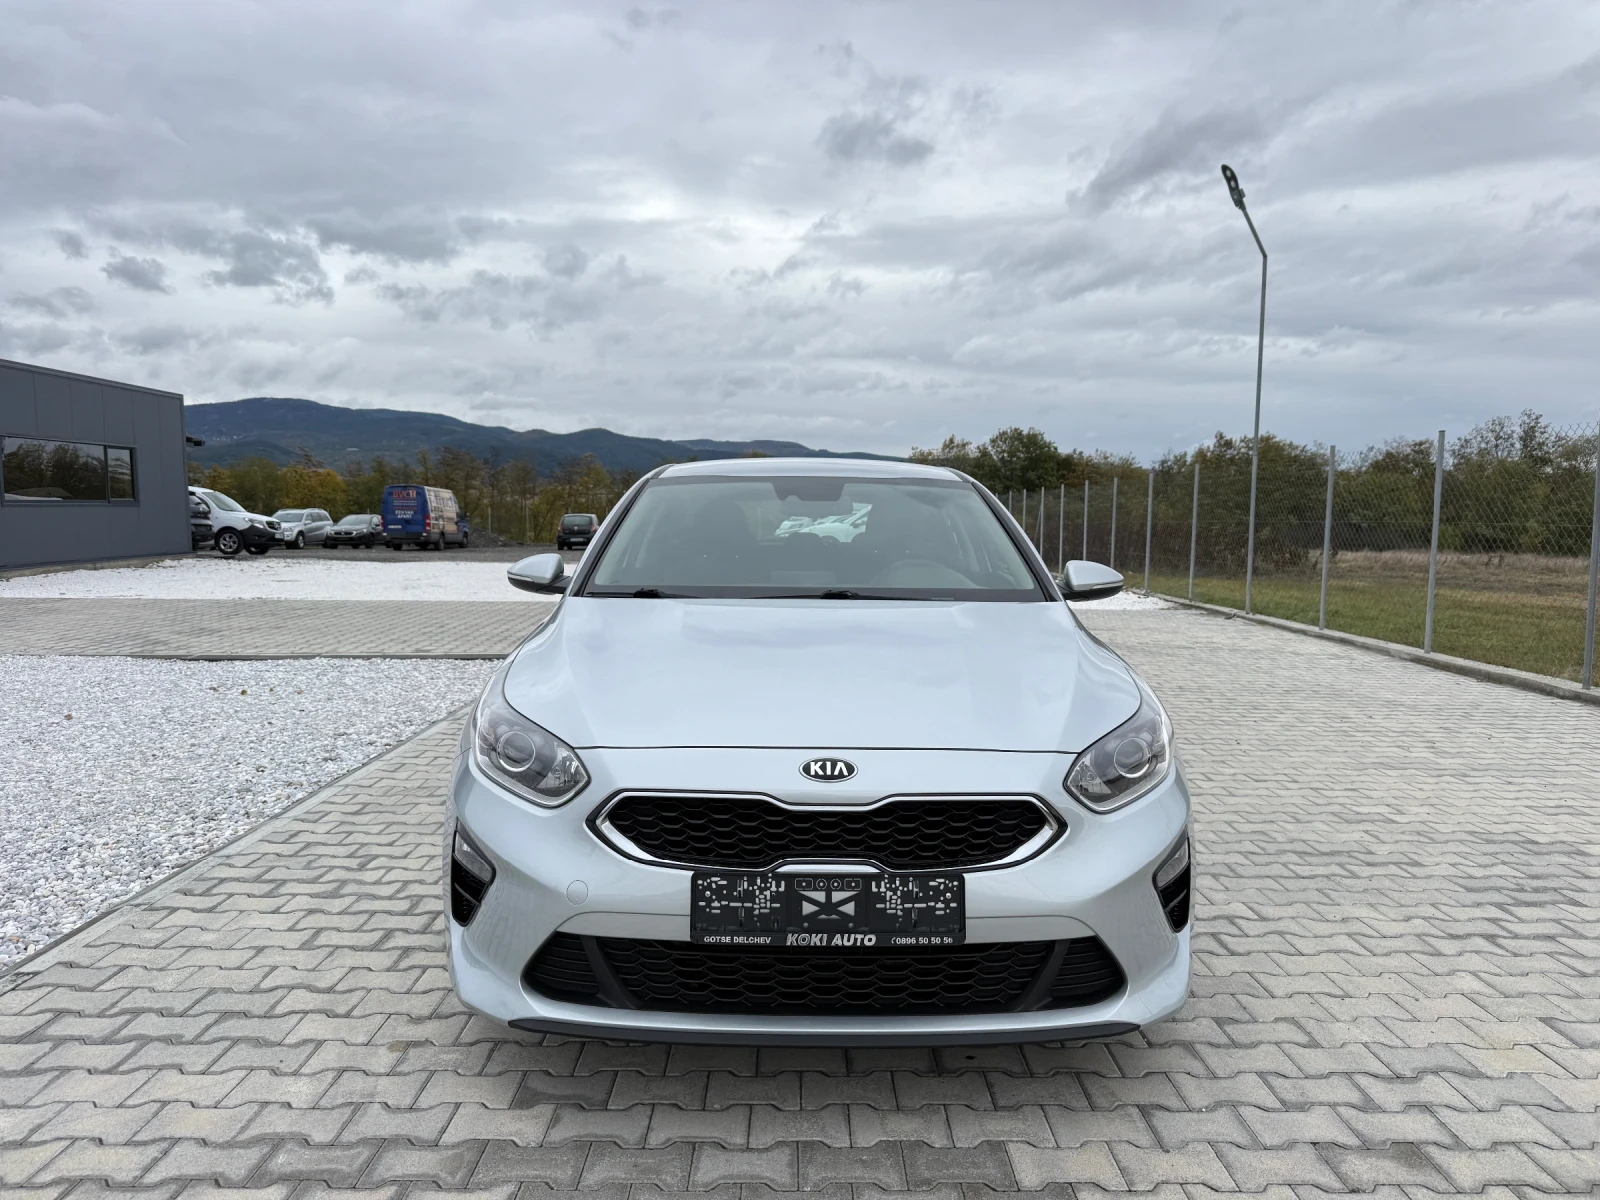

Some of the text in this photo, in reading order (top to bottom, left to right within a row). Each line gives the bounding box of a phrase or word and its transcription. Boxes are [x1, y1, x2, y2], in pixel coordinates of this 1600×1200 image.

[810, 761, 849, 776] KIA
[733, 936, 771, 944] DELCHEV
[785, 933, 877, 946] KOKI AUTO
[918, 936, 929, 944] 50
[930, 936, 942, 944] 50
